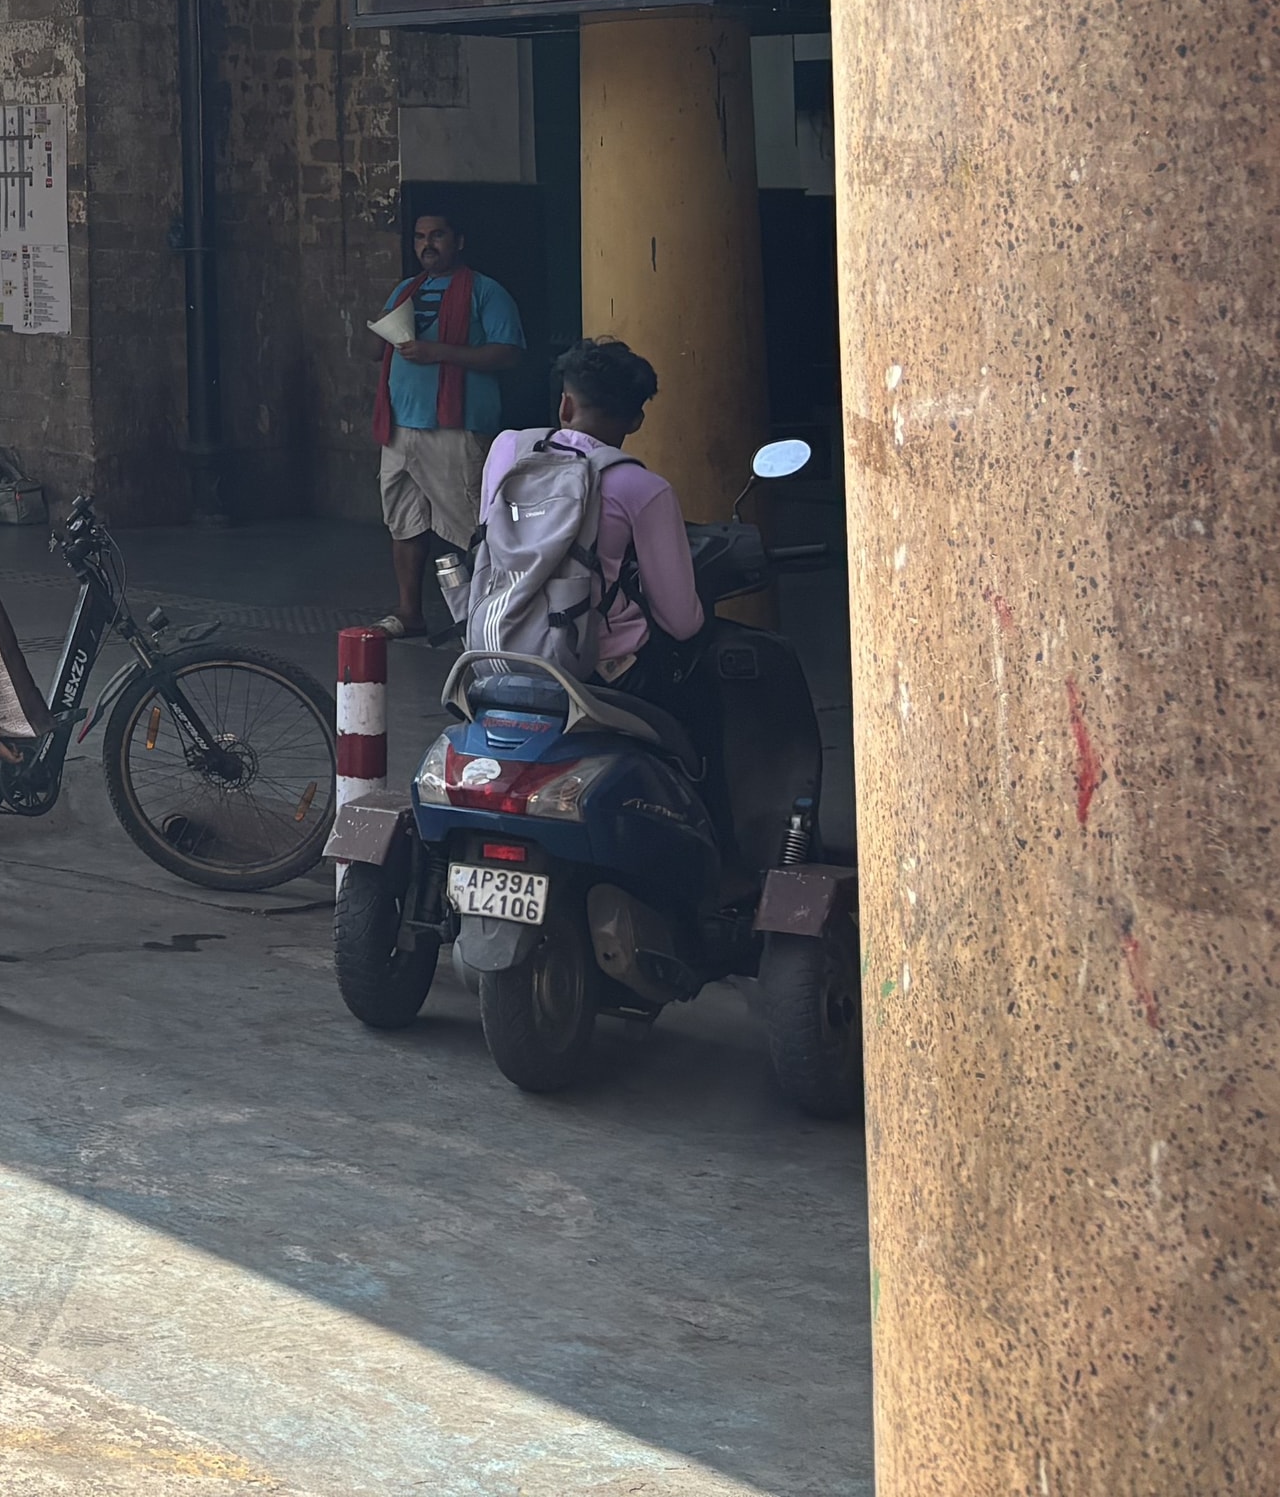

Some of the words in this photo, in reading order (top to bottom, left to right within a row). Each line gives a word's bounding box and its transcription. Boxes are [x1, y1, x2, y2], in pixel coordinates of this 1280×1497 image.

[61, 649, 88, 707] NEXZU
[467, 869, 535, 897] AP39A
[468, 891, 539, 921] L4106
